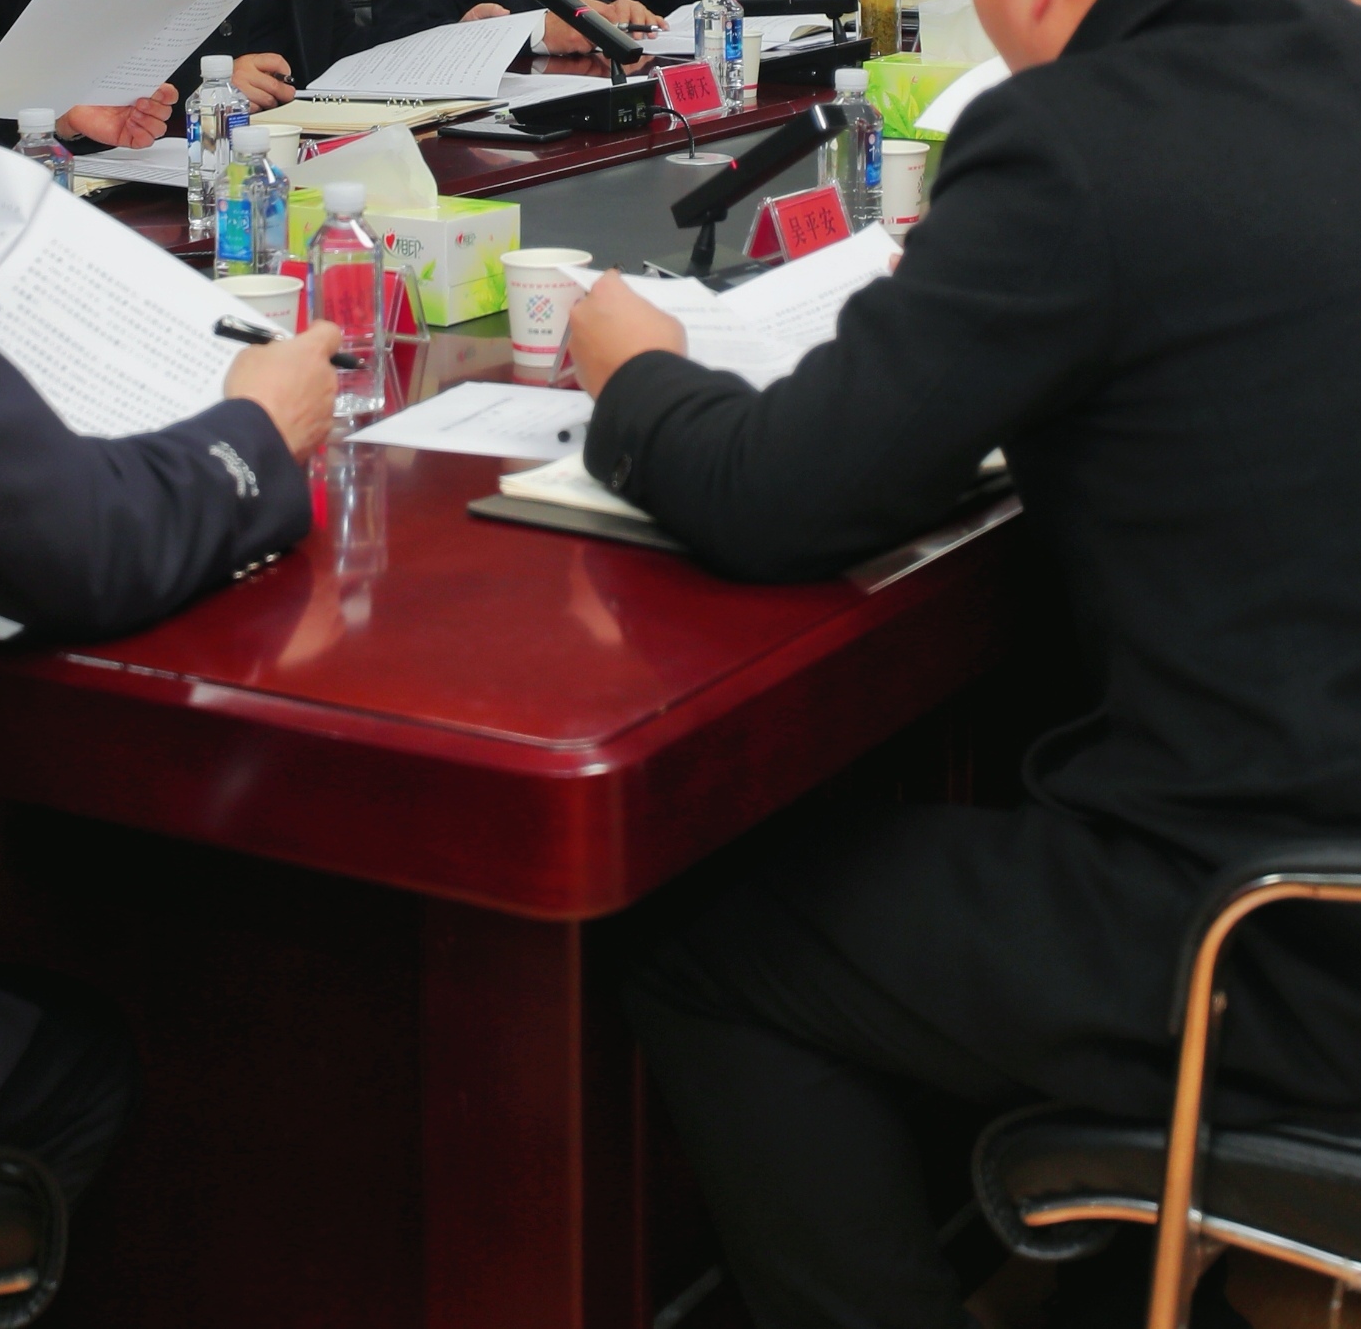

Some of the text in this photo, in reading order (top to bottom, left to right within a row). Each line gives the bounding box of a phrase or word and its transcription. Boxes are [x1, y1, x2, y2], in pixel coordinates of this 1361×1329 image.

[672, 75, 711, 103] 袁新天
[788, 206, 837, 248] 吴平安
